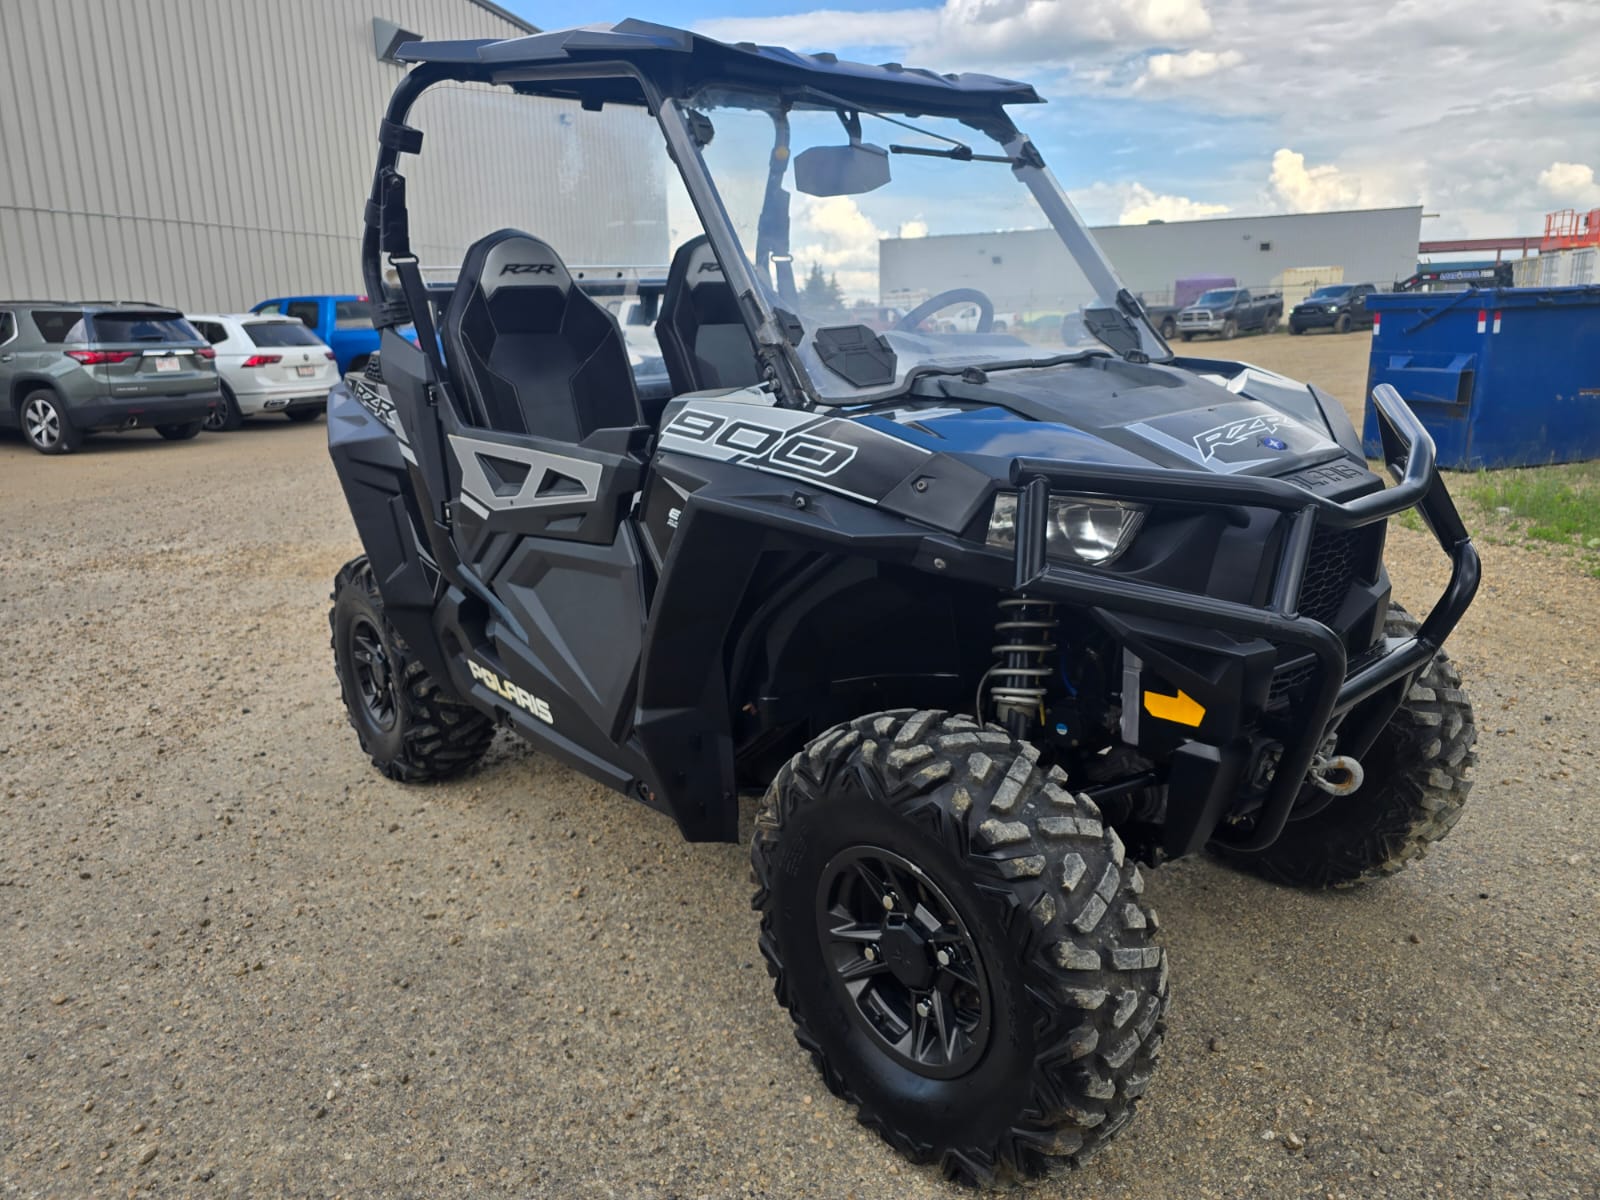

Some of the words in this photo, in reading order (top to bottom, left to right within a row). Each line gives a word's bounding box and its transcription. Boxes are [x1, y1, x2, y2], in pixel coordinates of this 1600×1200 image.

[499, 263, 556, 276] RZR
[697, 262, 723, 274] RZ
[355, 381, 396, 421] RZR
[661, 408, 858, 477] 900
[1193, 414, 1301, 463] RZR
[467, 659, 553, 724] POLARIS
